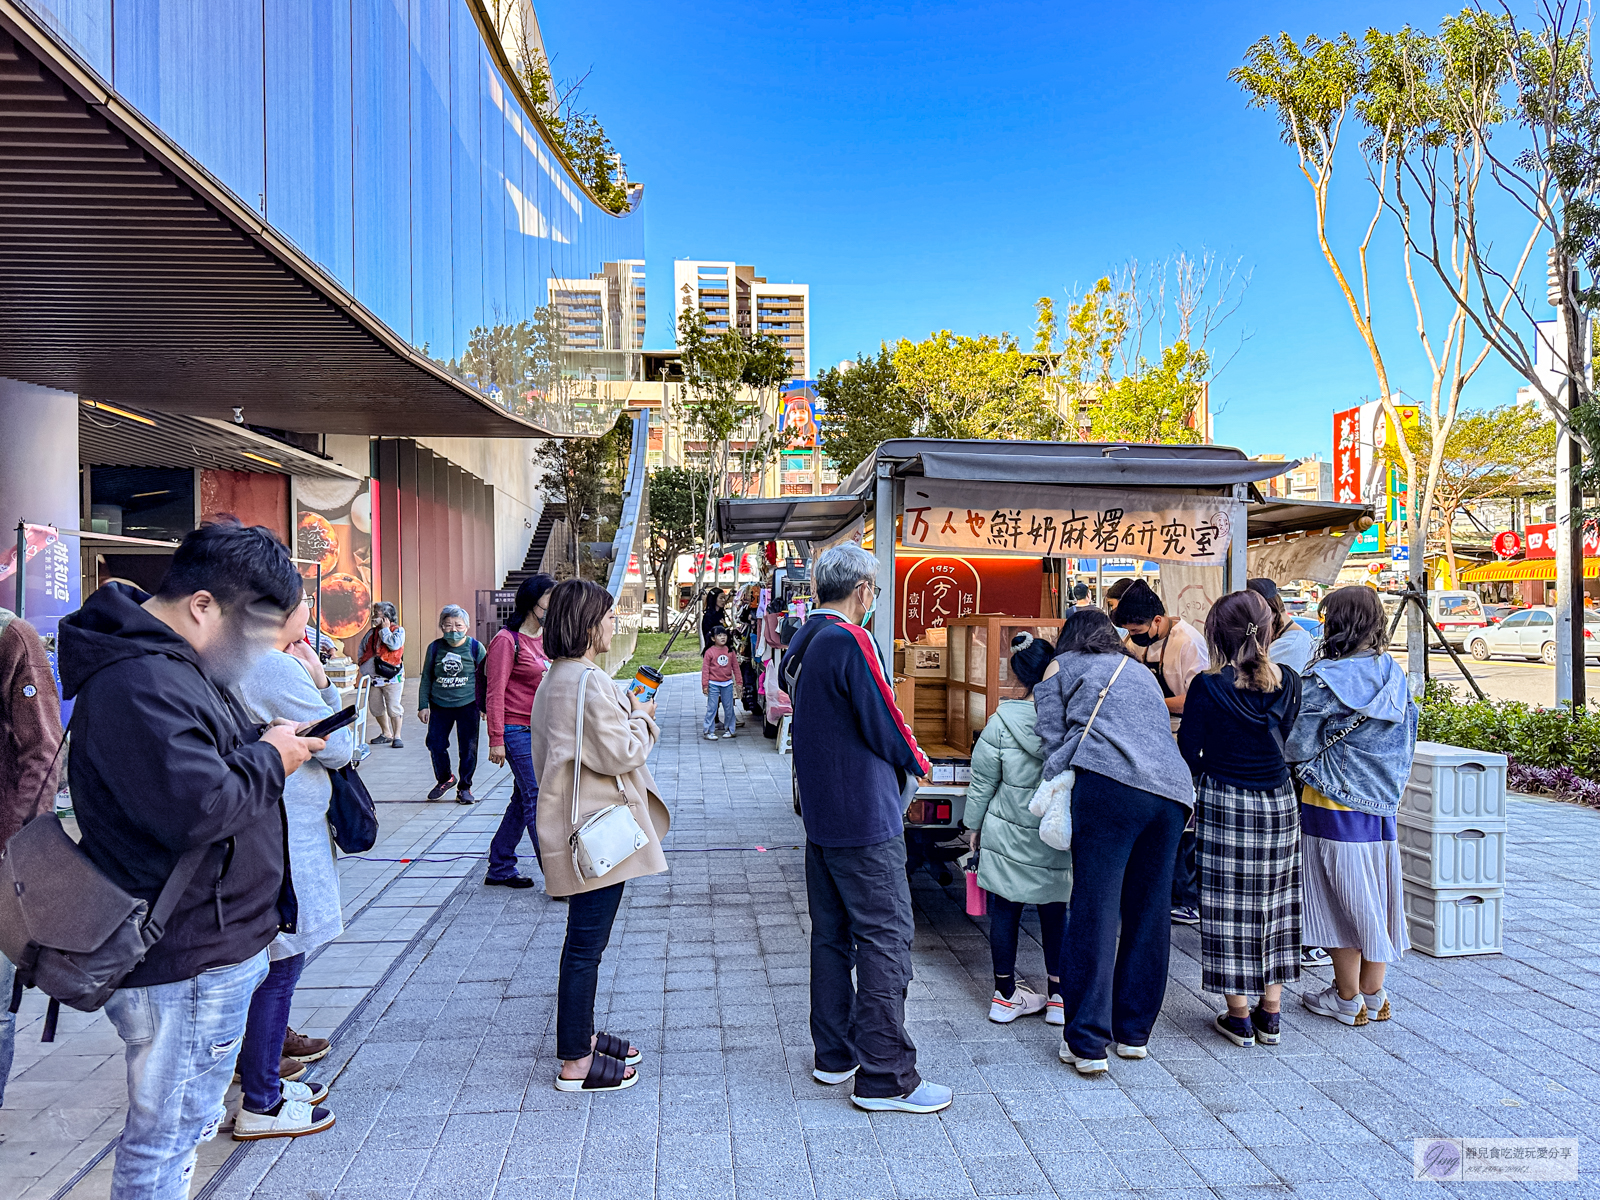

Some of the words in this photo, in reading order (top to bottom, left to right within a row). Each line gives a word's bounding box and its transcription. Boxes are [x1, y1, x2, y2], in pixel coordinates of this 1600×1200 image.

[1393, 547, 1402, 557] P
[930, 565, 955, 574] 1957
[908, 592, 920, 619] 壹玖
